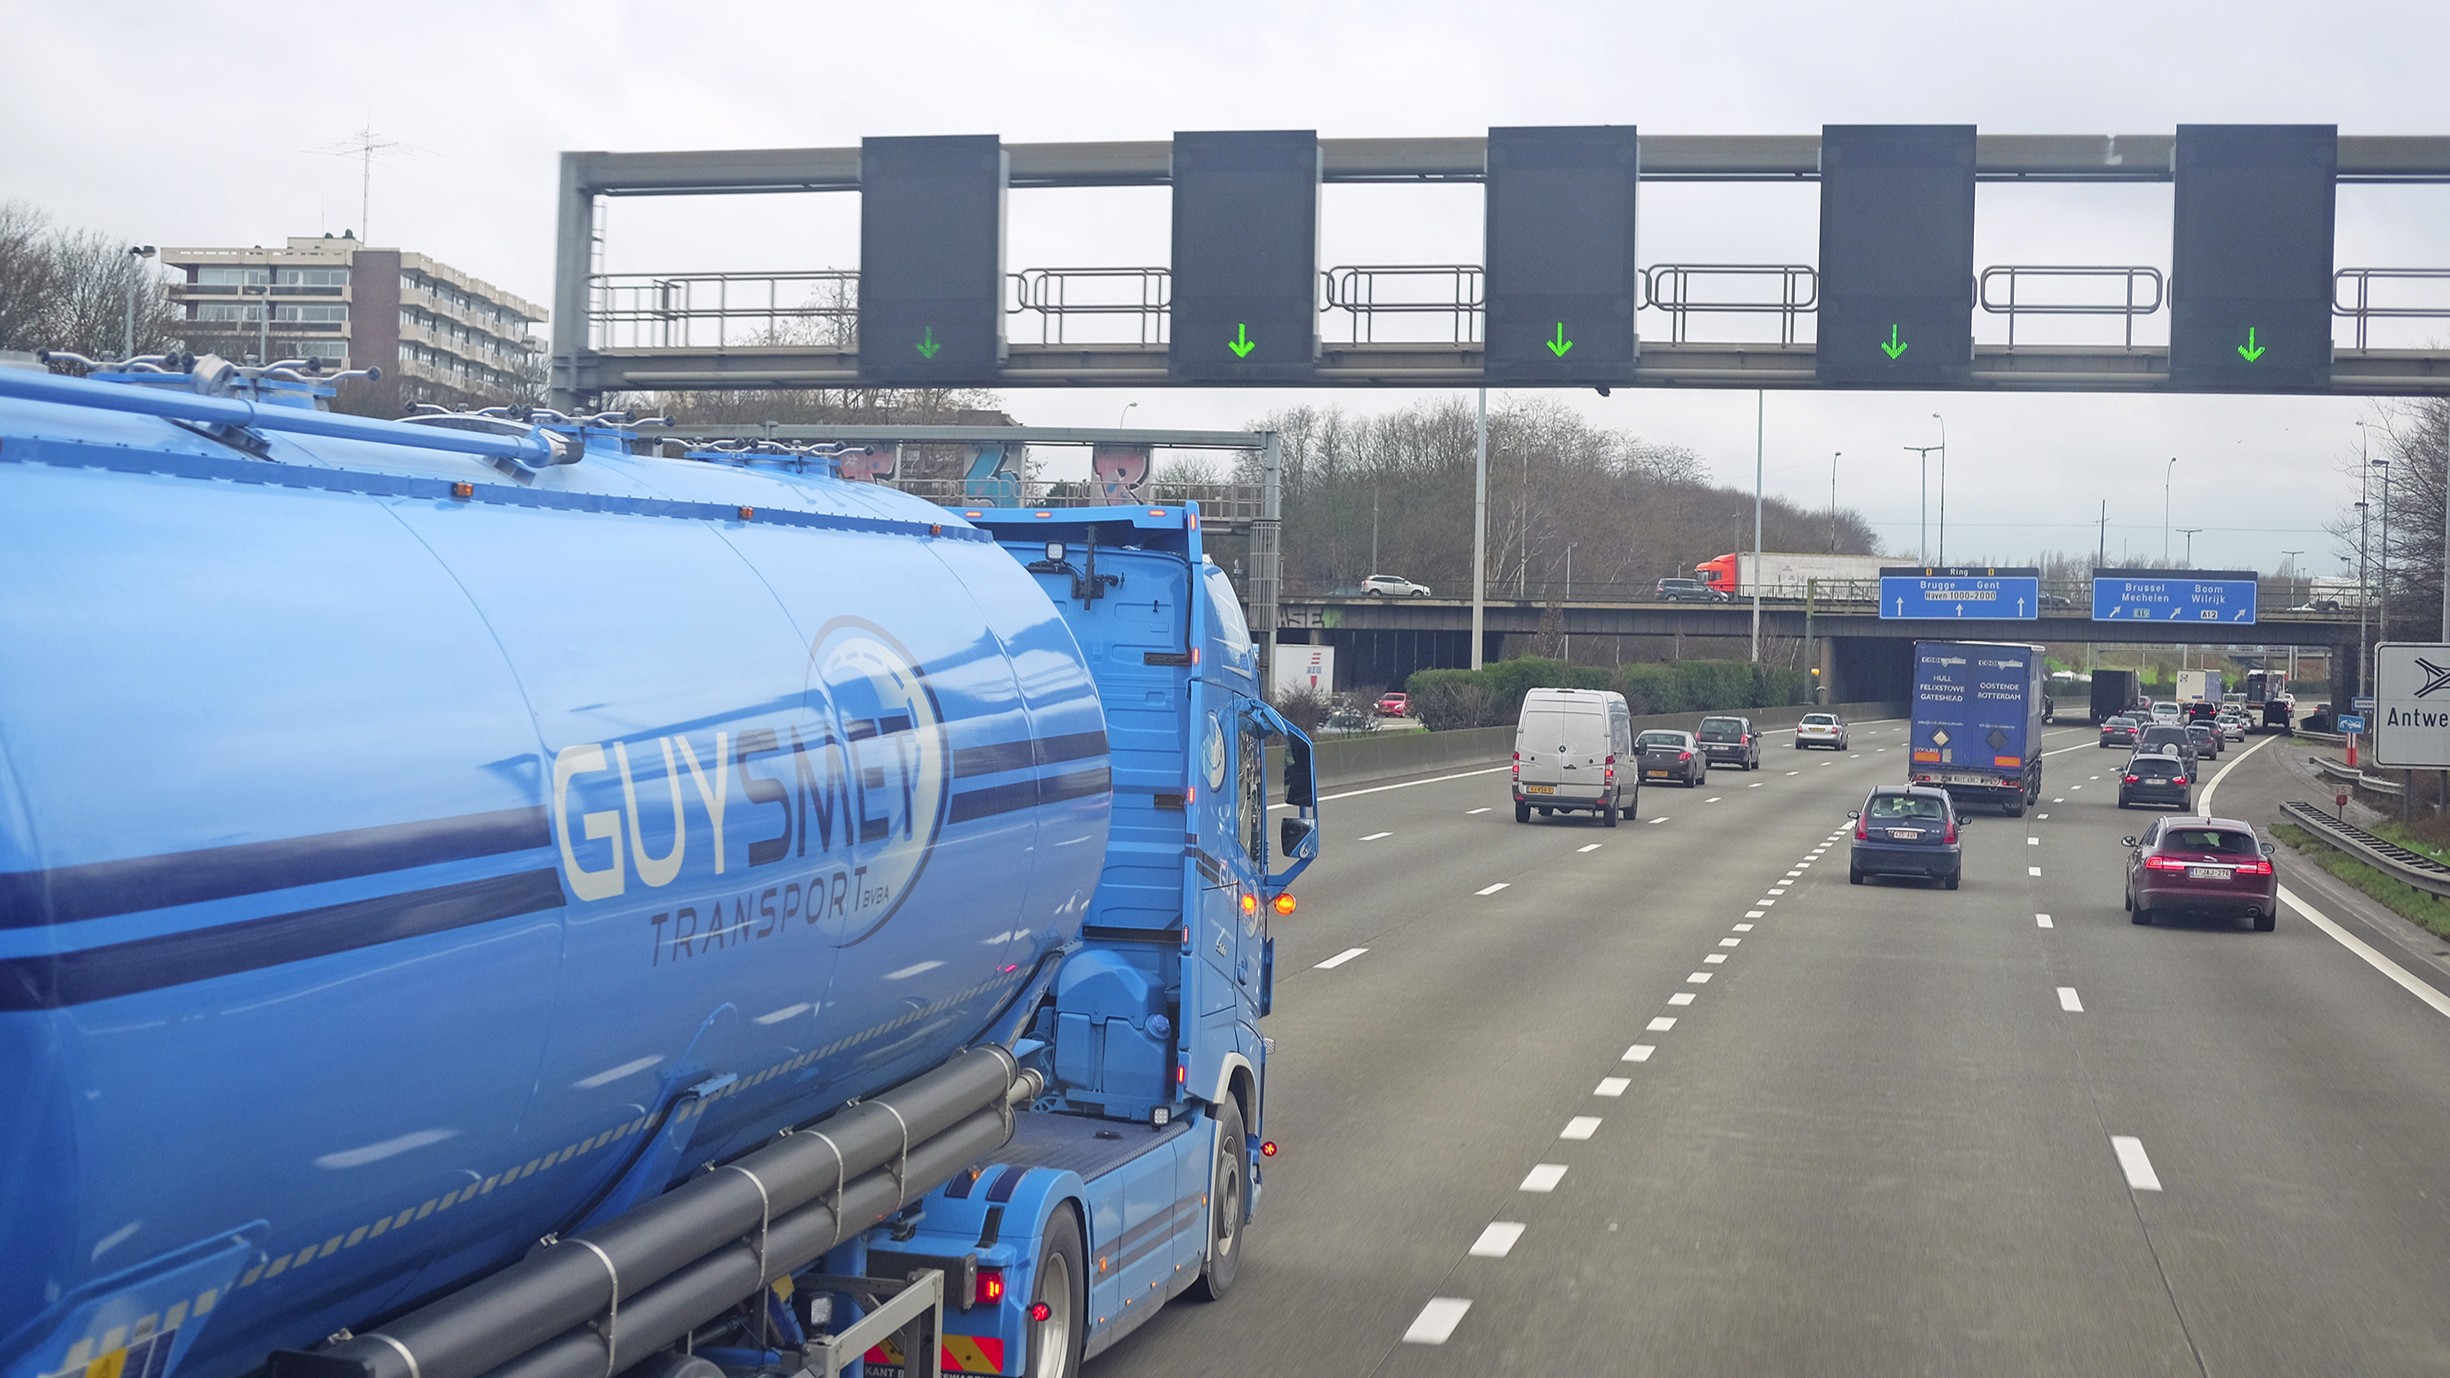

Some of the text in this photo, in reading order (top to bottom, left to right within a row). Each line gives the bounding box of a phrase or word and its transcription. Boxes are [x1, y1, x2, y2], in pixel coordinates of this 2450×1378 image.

[1950, 568, 1969, 577] Ring
[1920, 581, 2000, 590] Brugge Gent
[2125, 583, 2223, 594] Brussel Boom
[1925, 592, 1997, 600] Haven 1000-2000
[2121, 593, 2226, 606] Mechelen Wilrijk
[2201, 611, 2217, 619] A12
[1920, 683, 1965, 693] FELIXSTOWE
[1979, 682, 2019, 691] OOSTENDE
[1920, 693, 1963, 702] GATESHEAD
[1977, 691, 2021, 701] ROTTERDAM
[2387, 707, 2449, 728] Antwe
[651, 866, 889, 967] TRANSPORT BVBA
